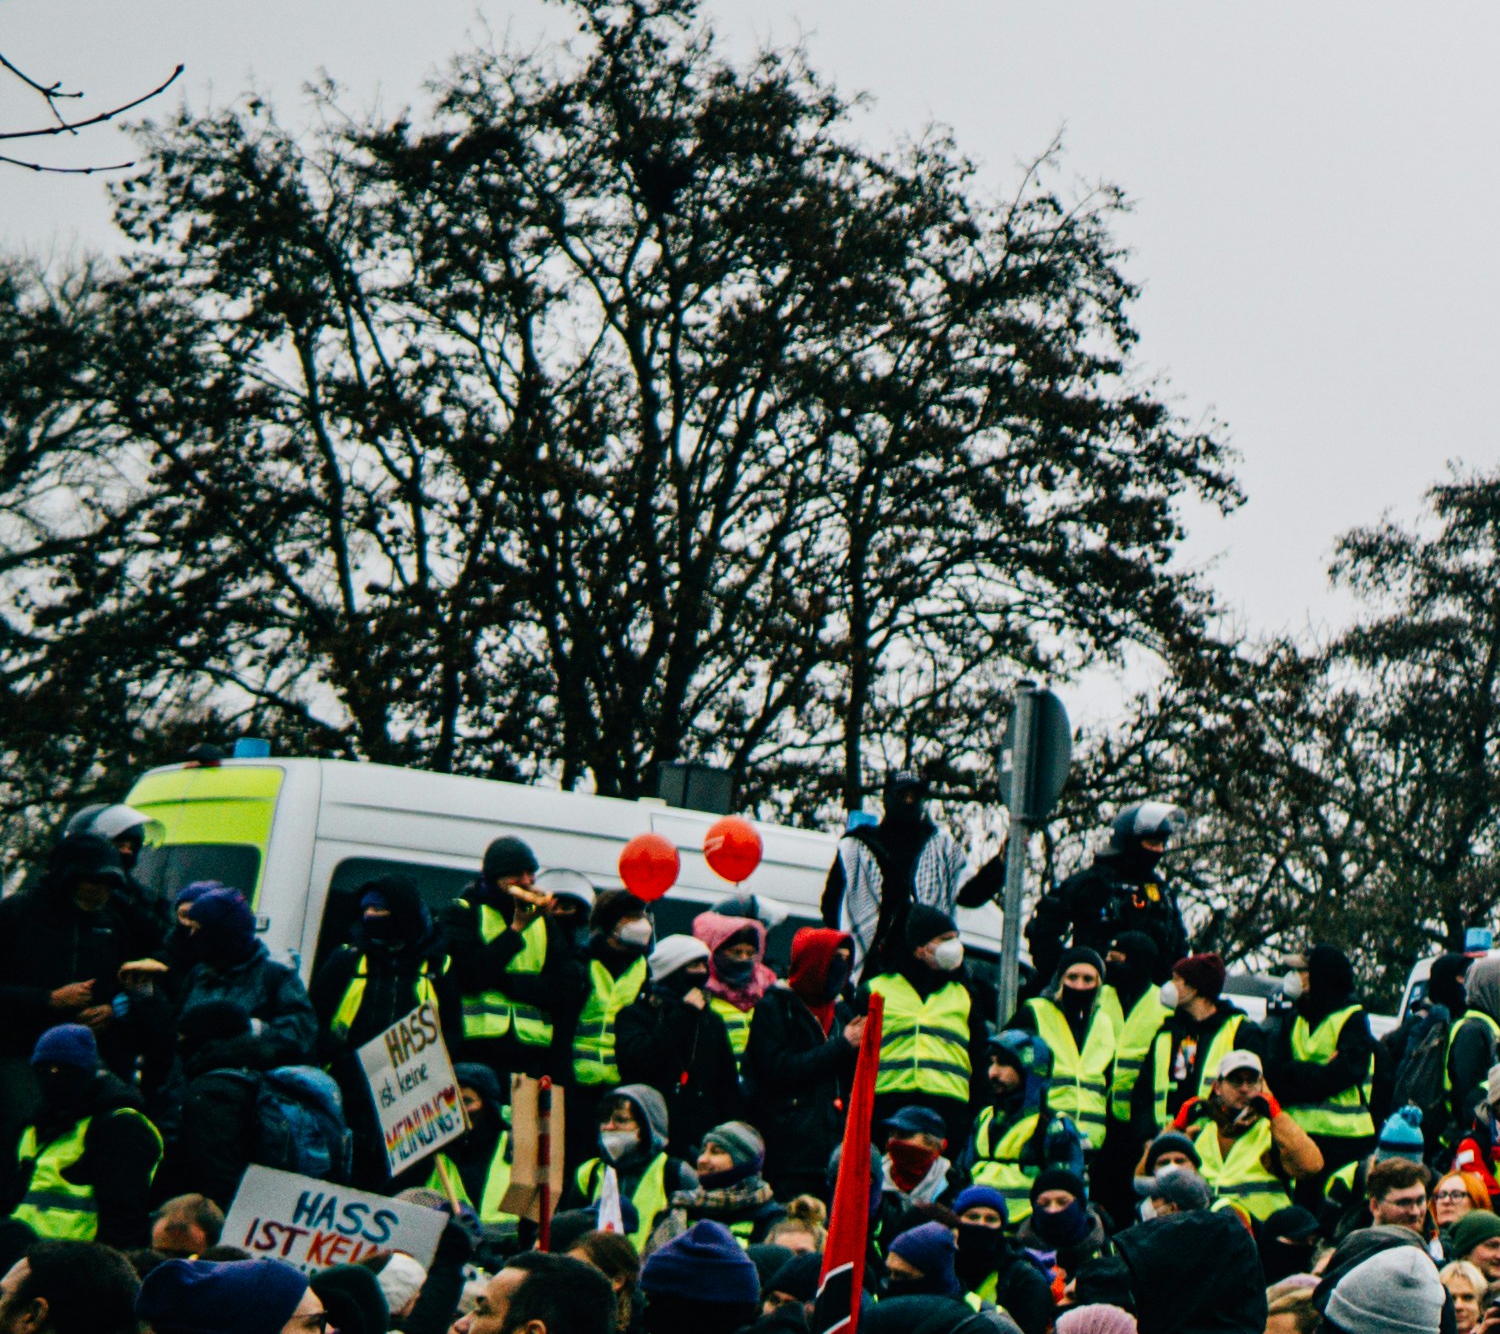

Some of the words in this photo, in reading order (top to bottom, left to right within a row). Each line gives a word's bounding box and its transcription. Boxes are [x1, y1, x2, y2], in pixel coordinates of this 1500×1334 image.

[384, 1003, 438, 1069] HASS
[396, 1062, 429, 1096] keine
[244, 1217, 311, 1257] IST
[292, 1190, 400, 1245] HASS
